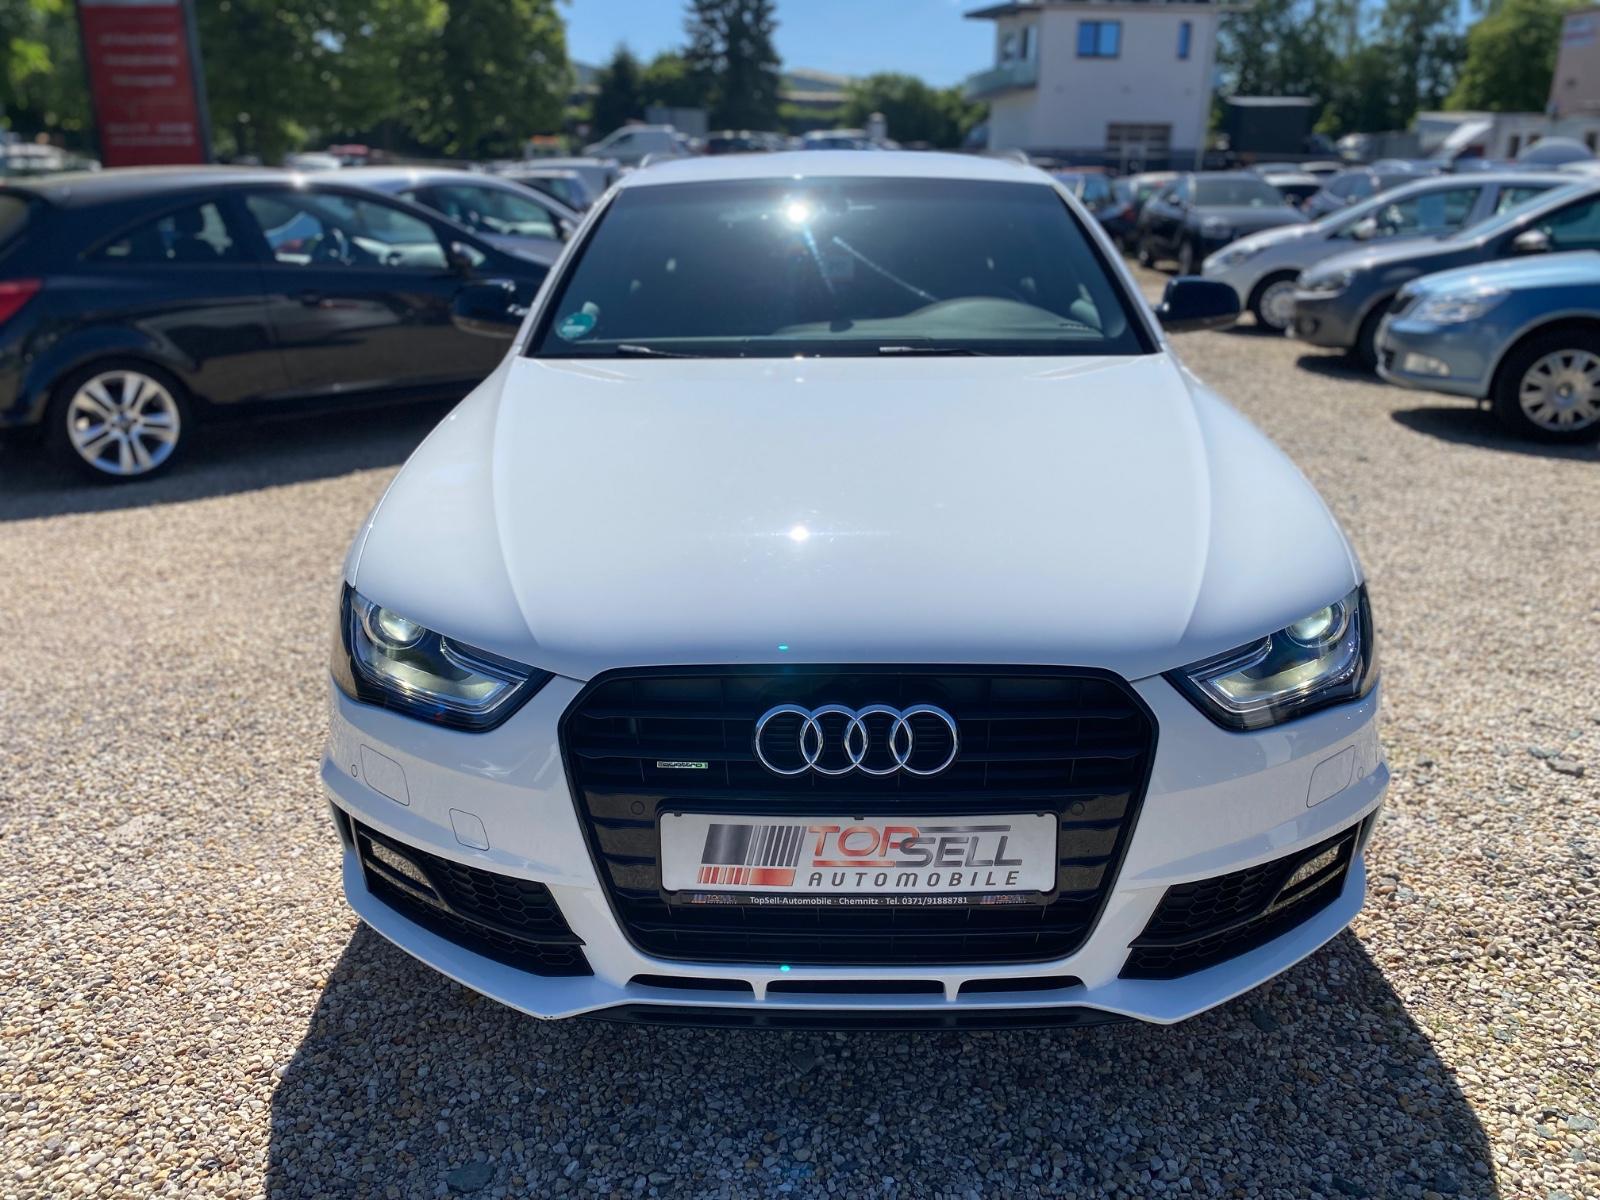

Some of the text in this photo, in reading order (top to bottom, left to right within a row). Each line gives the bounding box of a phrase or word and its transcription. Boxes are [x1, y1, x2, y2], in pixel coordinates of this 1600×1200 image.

[808, 870, 1020, 888] AUTOMOBILE
[749, 896, 832, 906] TopSell-Automobile
[838, 896, 879, 905] Chemnitz
[885, 896, 900, 905] Tel.
[902, 896, 968, 906] 0371/91888781
